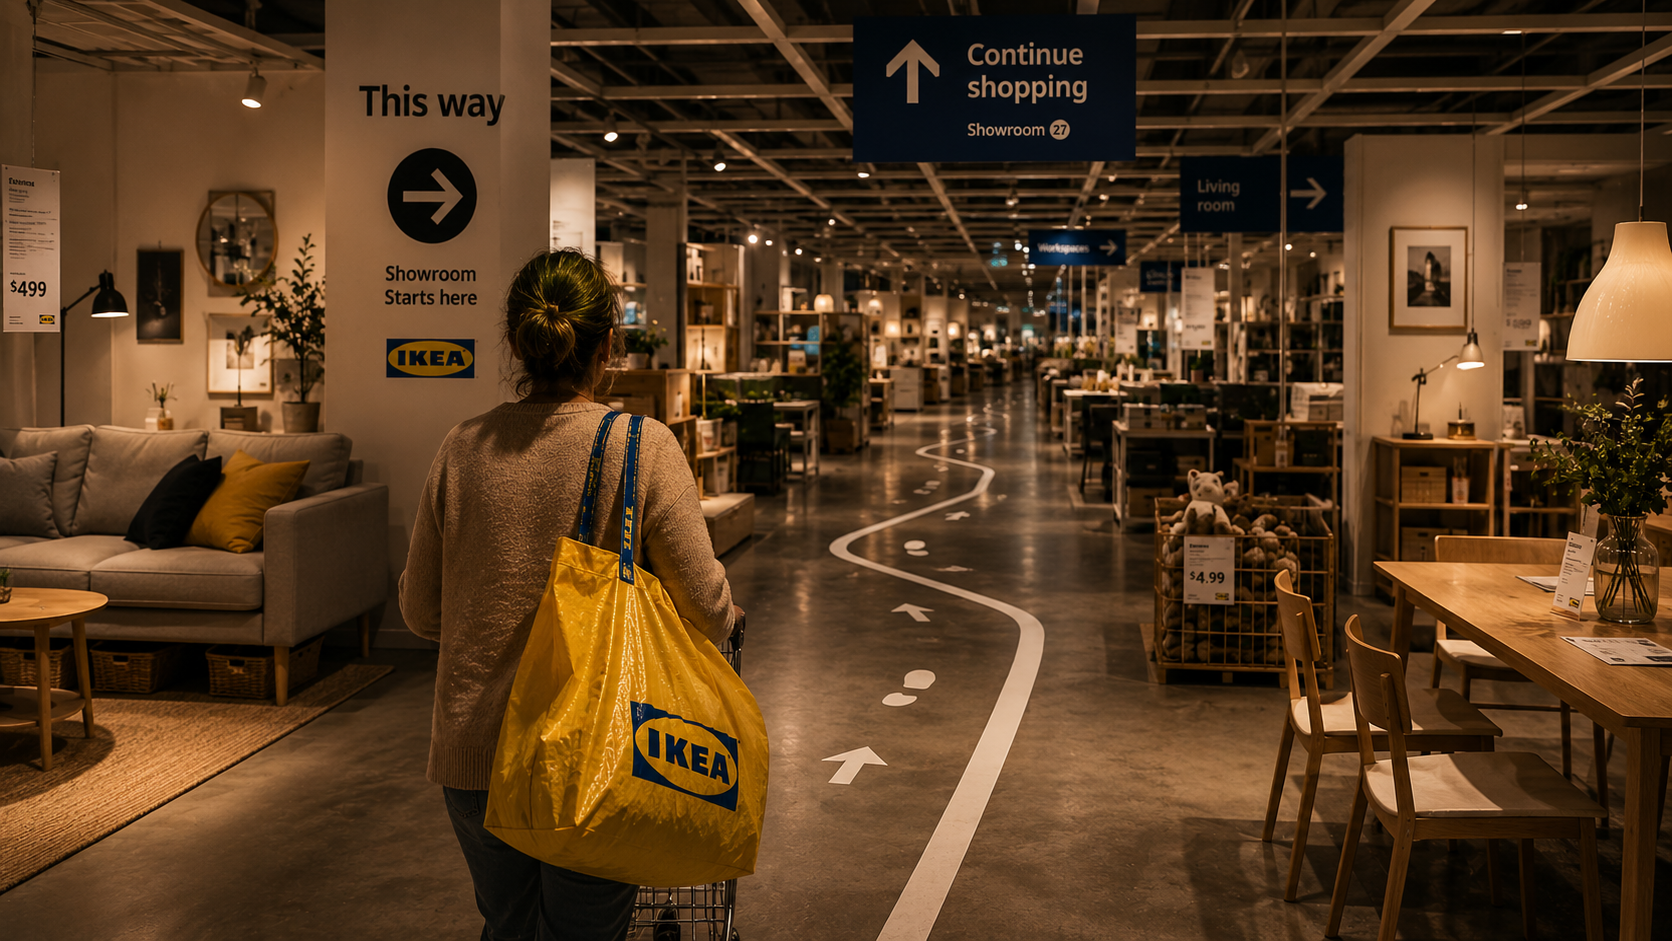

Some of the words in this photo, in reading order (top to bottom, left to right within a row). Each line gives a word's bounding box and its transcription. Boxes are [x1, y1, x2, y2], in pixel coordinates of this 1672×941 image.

[967, 42, 1083, 66] Continue
[967, 74, 1088, 104] shopping
[359, 85, 428, 117] This
[438, 93, 505, 126] way
[967, 122, 1045, 137] Showroom
[1053, 125, 1067, 135] 27
[1197, 179, 1240, 198] Living
[1197, 199, 1235, 213] room
[1037, 242, 1090, 255] Workspaces
[385, 265, 476, 282] Showroom
[10, 280, 47, 297] $499
[385, 289, 435, 305] Starts
[440, 289, 477, 305] here
[398, 350, 465, 366] IKEA
[1189, 571, 1225, 584] $4.99
[648, 728, 731, 785] IKEA
